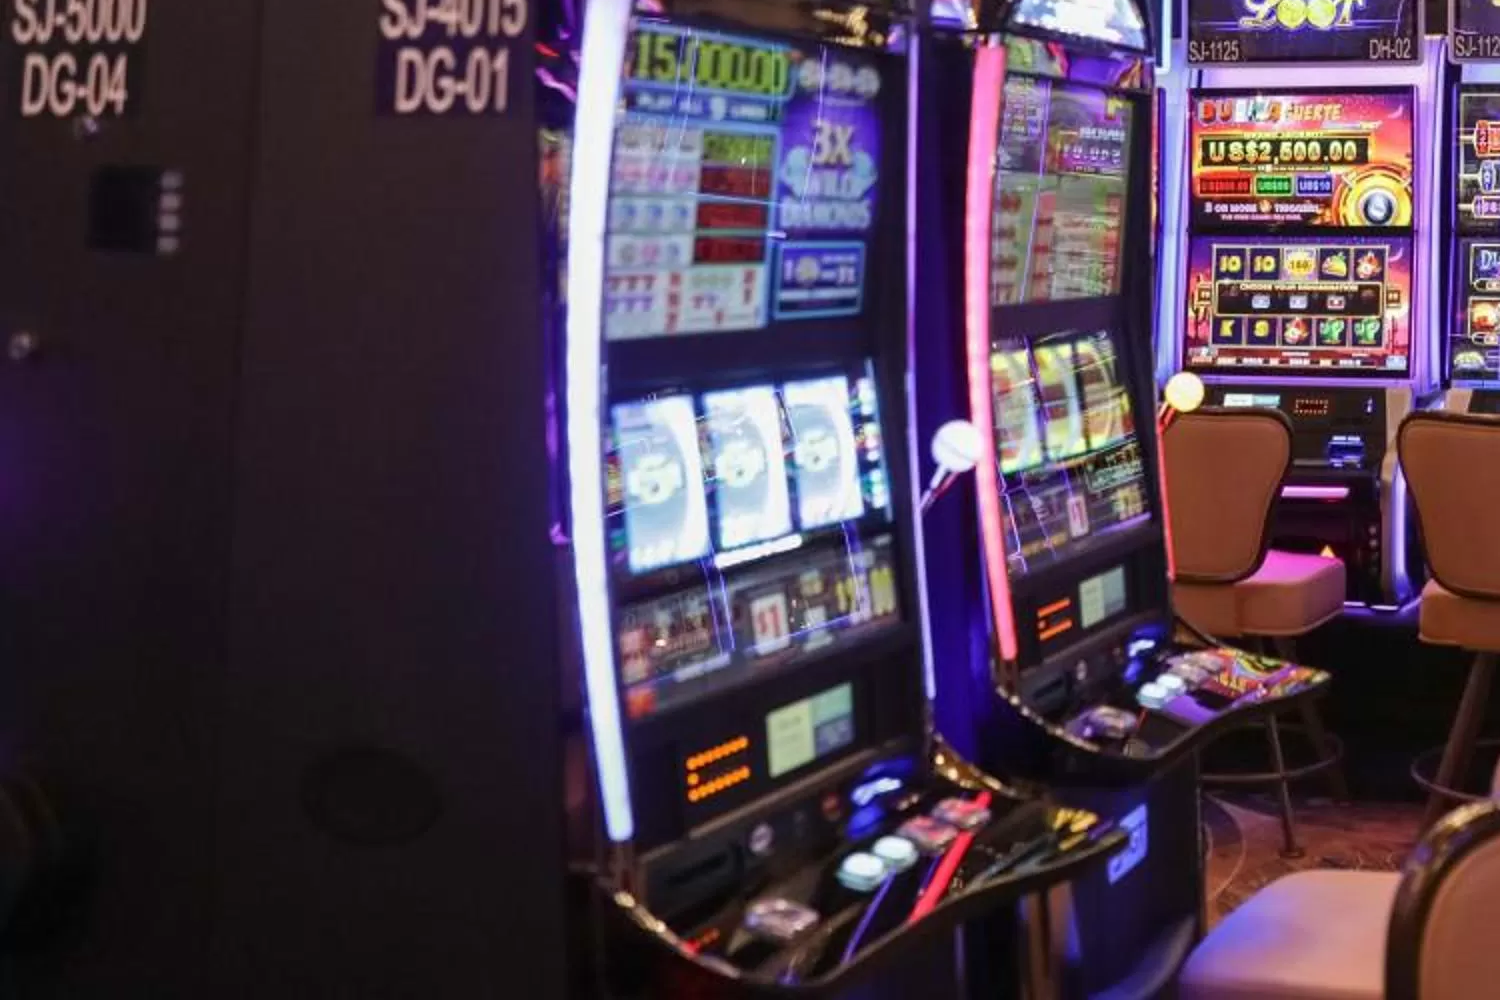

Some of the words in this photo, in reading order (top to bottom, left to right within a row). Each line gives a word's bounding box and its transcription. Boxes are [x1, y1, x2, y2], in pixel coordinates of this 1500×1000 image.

[1189, 40, 1240, 61] SJ-1125
[1369, 38, 1412, 59] DH-02
[22, 55, 128, 116] DG-04
[395, 49, 510, 114] DG-01
[813, 119, 856, 167] 3X
[1209, 140, 1358, 164] US$2,500.00
[1219, 255, 1241, 272] 10
[1253, 255, 1276, 272] 10
